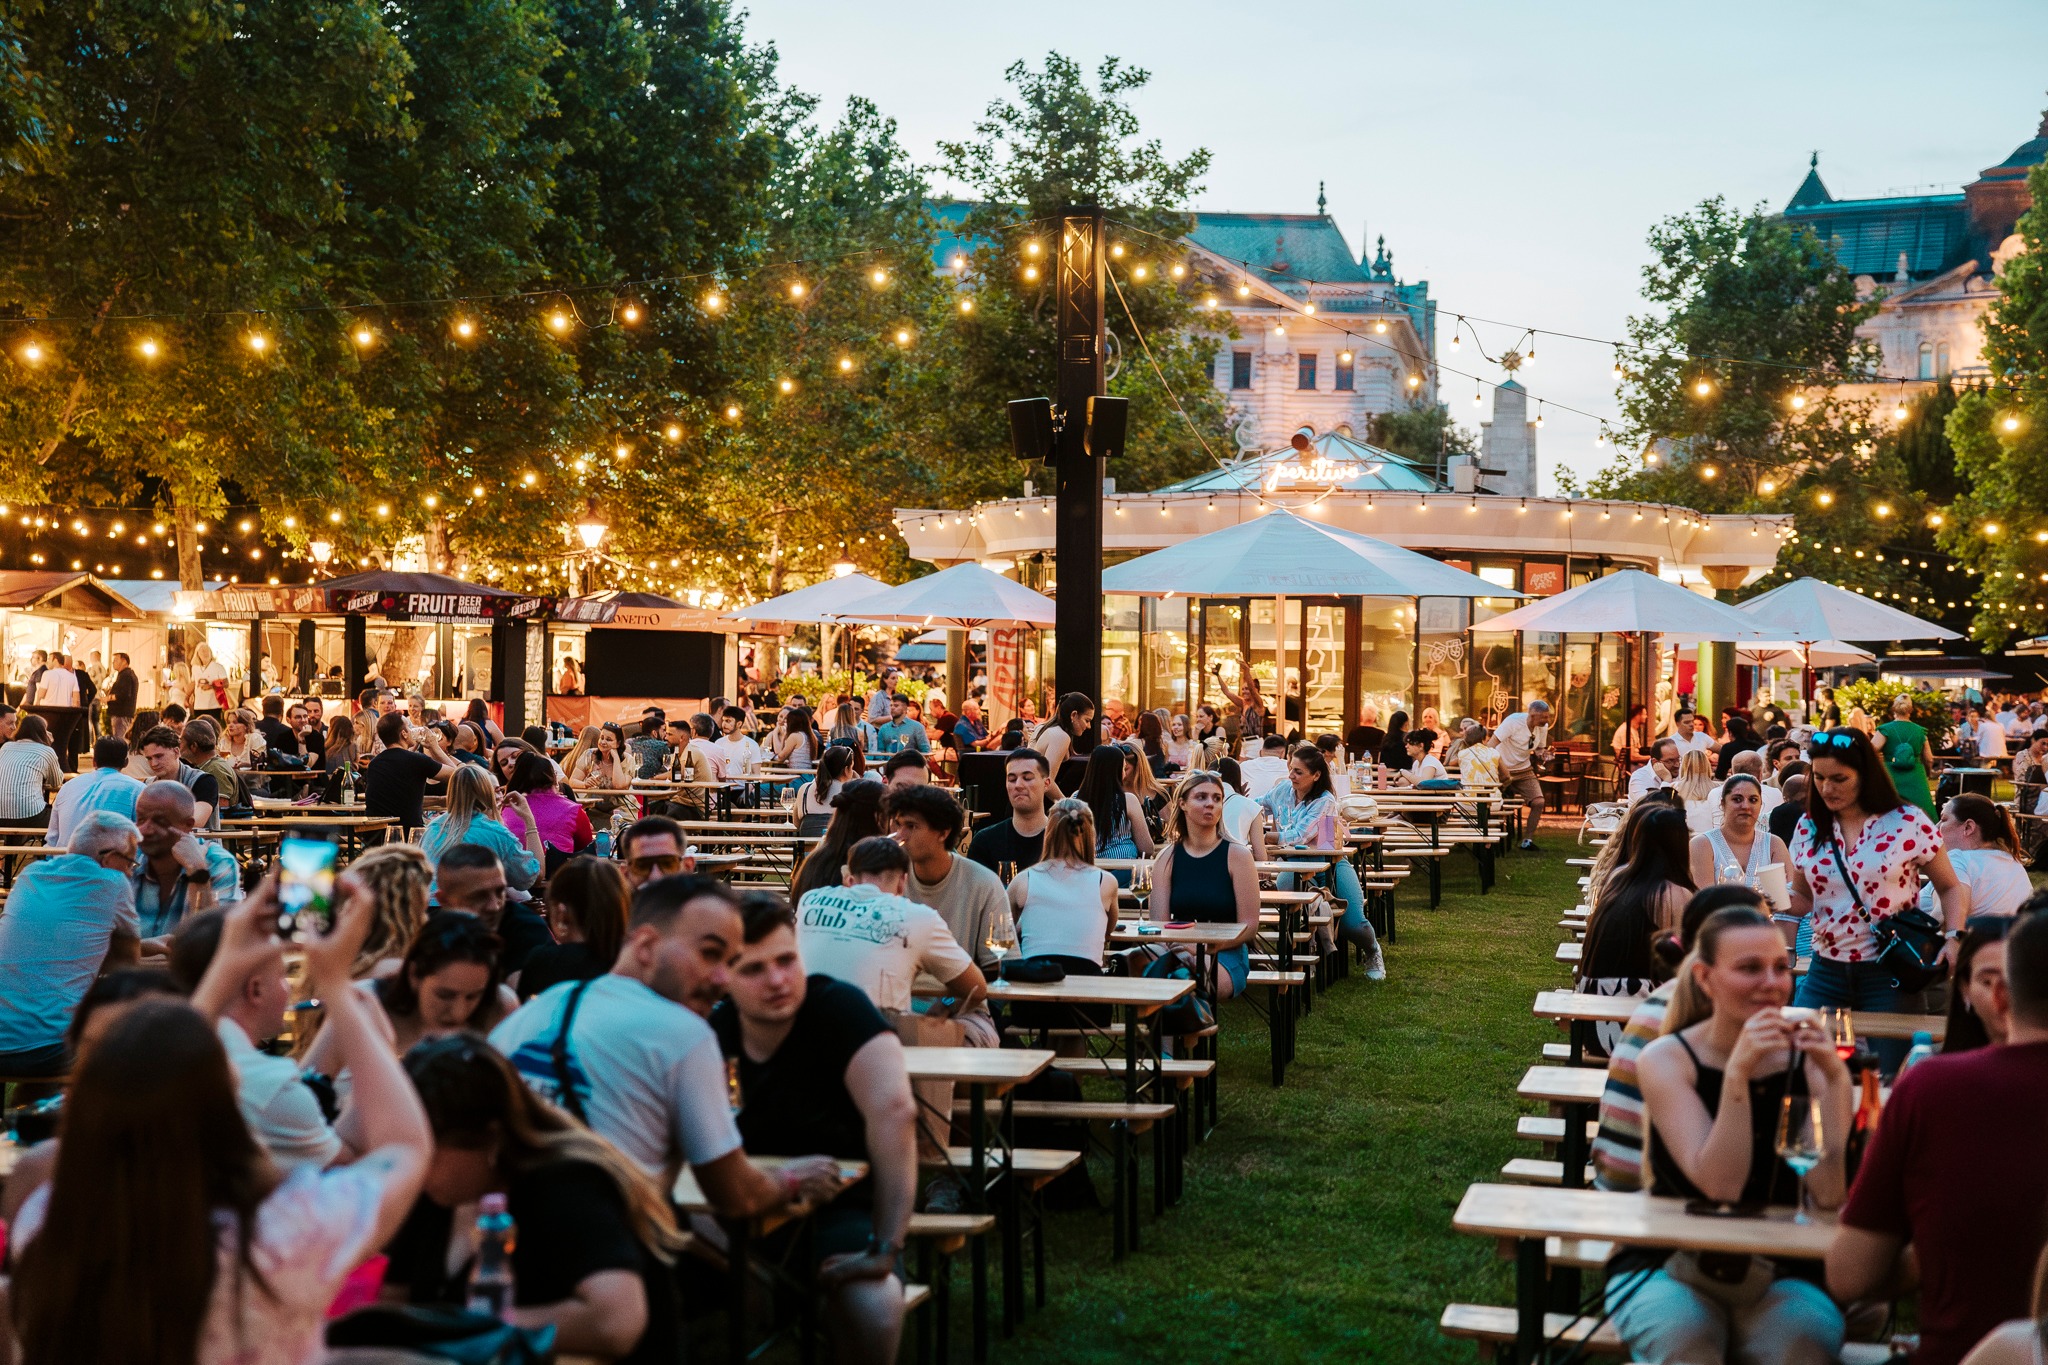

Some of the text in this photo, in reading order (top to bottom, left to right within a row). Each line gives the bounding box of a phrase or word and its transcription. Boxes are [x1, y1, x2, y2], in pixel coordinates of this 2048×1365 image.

[222, 592, 257, 612] FRUIT
[408, 593, 458, 614] FRUIT
[457, 605, 481, 615] HOUSE
[458, 595, 482, 606] BEER
[803, 893, 867, 918] Country
[804, 908, 847, 929] Club
